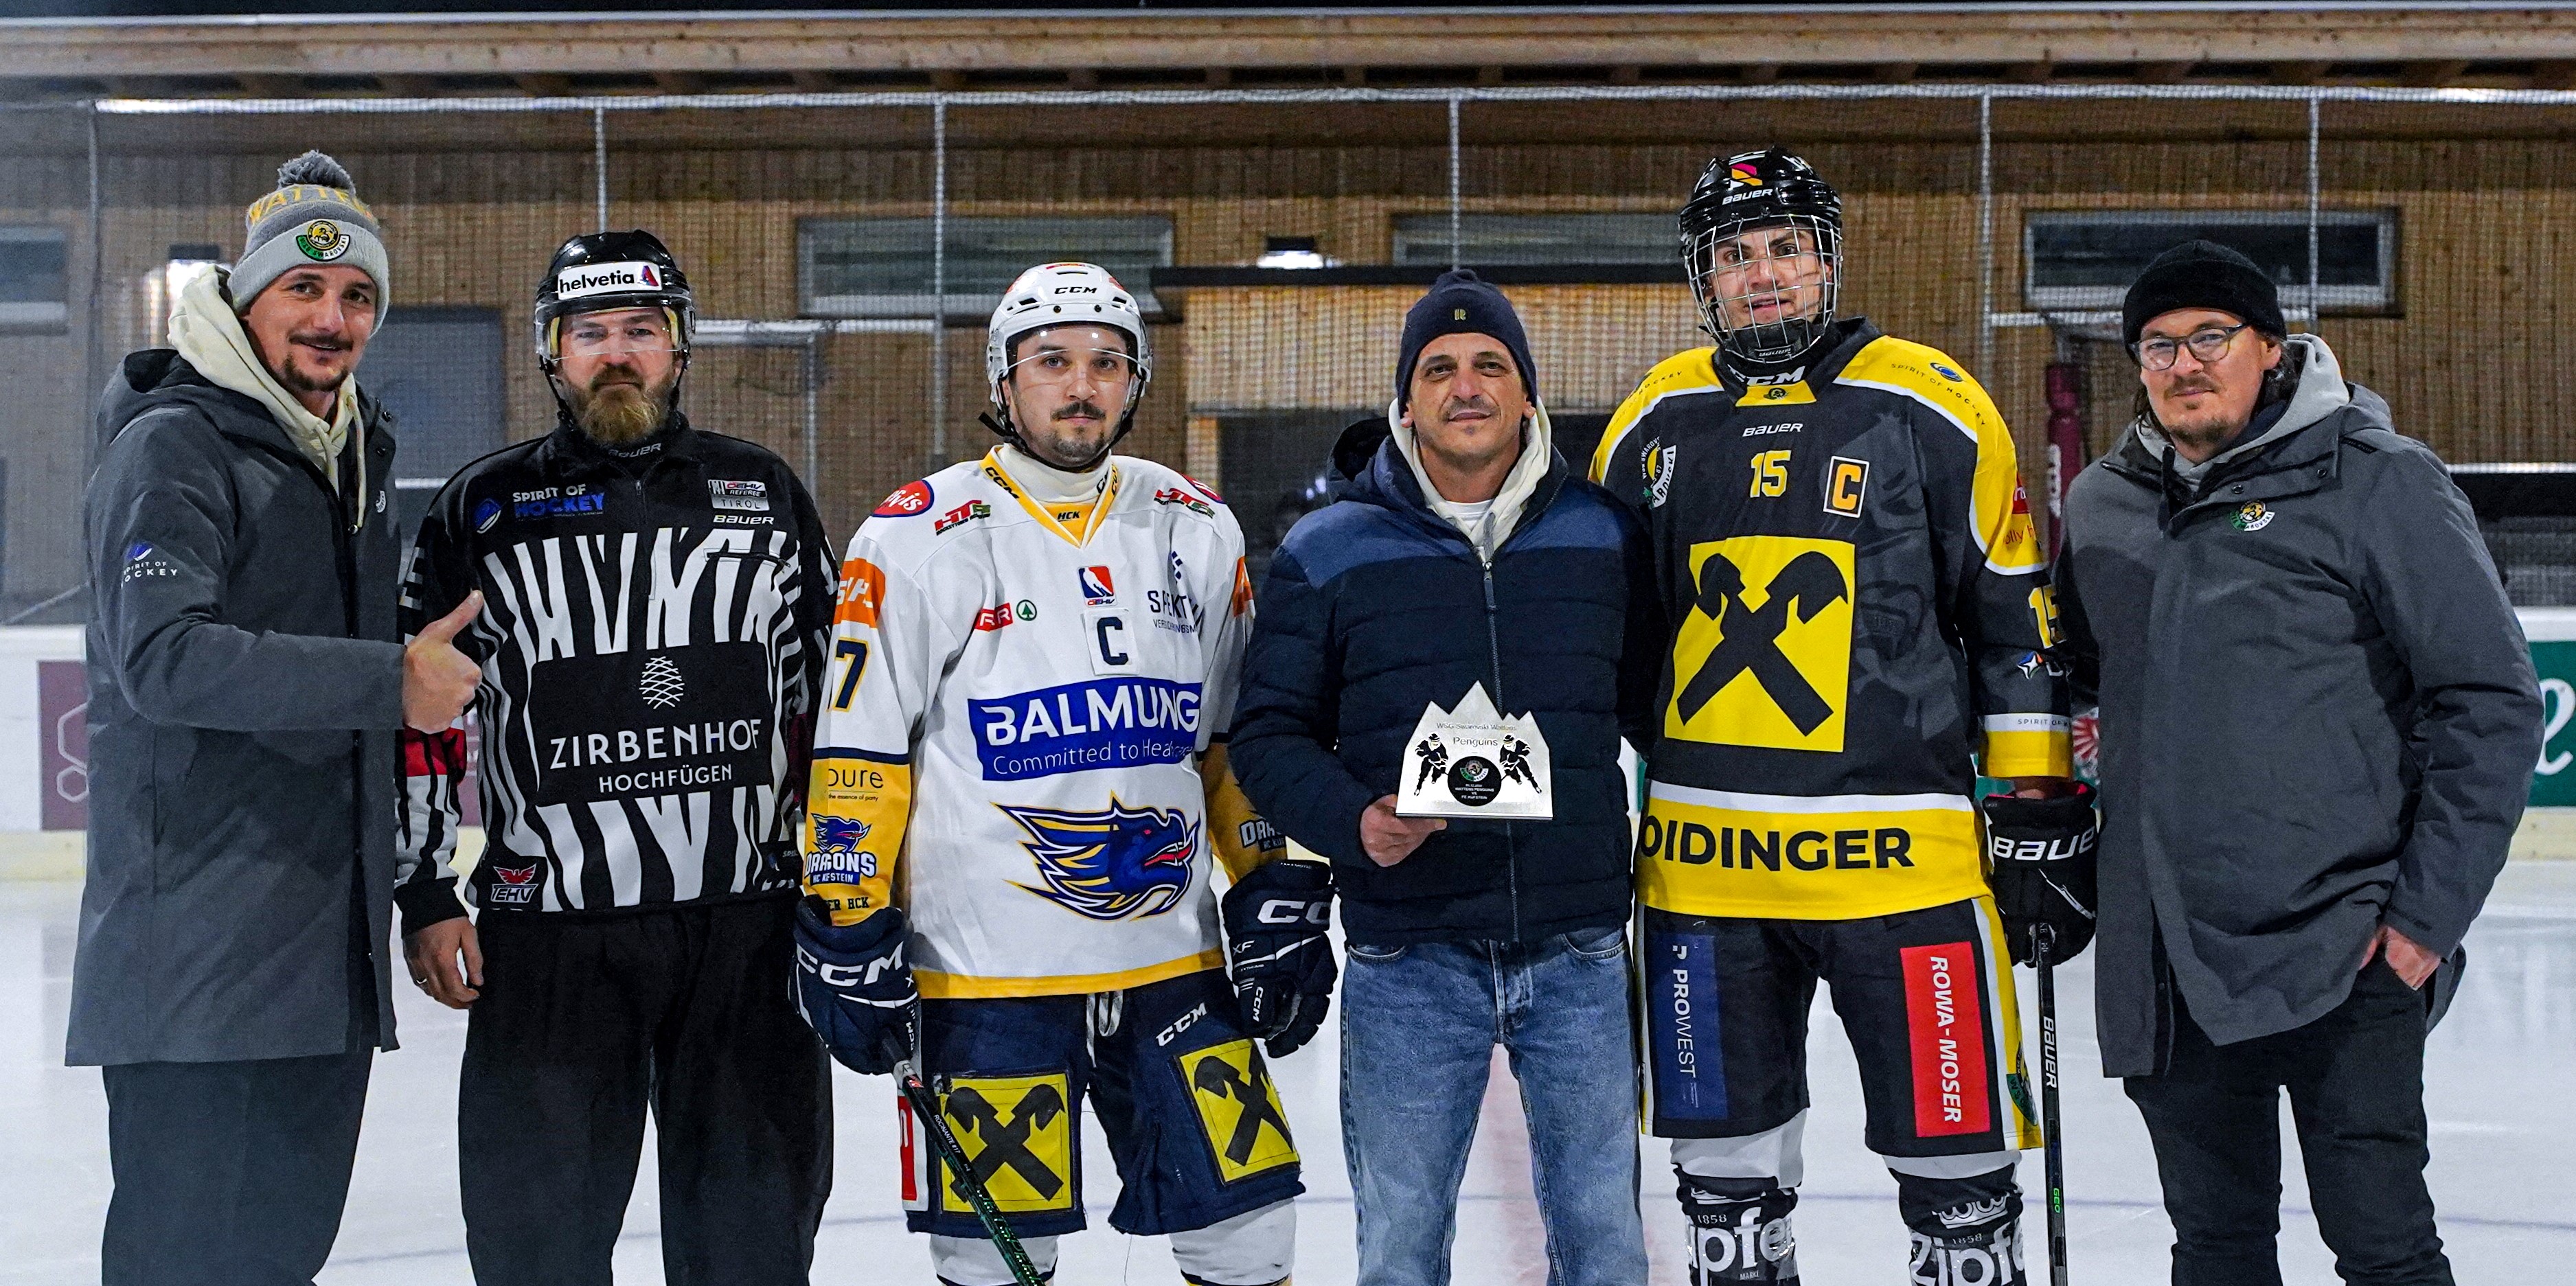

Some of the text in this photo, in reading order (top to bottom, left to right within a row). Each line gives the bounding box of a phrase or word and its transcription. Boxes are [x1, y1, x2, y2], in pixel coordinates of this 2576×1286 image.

[559, 270, 635, 293] helvetia
[1054, 286, 1097, 295] CCM
[1891, 363, 1926, 378] SPIRIT
[985, 466, 1020, 500] CCM
[1749, 450, 1792, 498] 15
[1832, 463, 1862, 511] C
[512, 483, 586, 503] SPIRIT OF
[514, 492, 605, 518] HOCKEY
[720, 498, 762, 509] TIROL
[1058, 510, 1081, 521] HCK
[1097, 617, 1129, 666] C
[980, 685, 1200, 746] BALMUNG
[549, 719, 762, 770] ZIRBENHOF
[993, 741, 1112, 774] Committed
[1119, 742, 1139, 761] to
[1453, 737, 1498, 748] Penguins
[599, 763, 733, 794] HOCHFÜGEN
[1640, 814, 1915, 872] OIDINGER
[797, 941, 904, 987] CCM
[1253, 986, 1264, 1022] CCM
[1156, 1002, 1208, 1046] CCM
[1672, 969, 1696, 1079] PROWEST
[1930, 956, 1962, 1123] ROWA-MOSER
[2053, 1187, 2061, 1214] GEO
[1697, 1214, 1728, 1225] 1858
[1952, 1233, 1983, 1245] 1858
